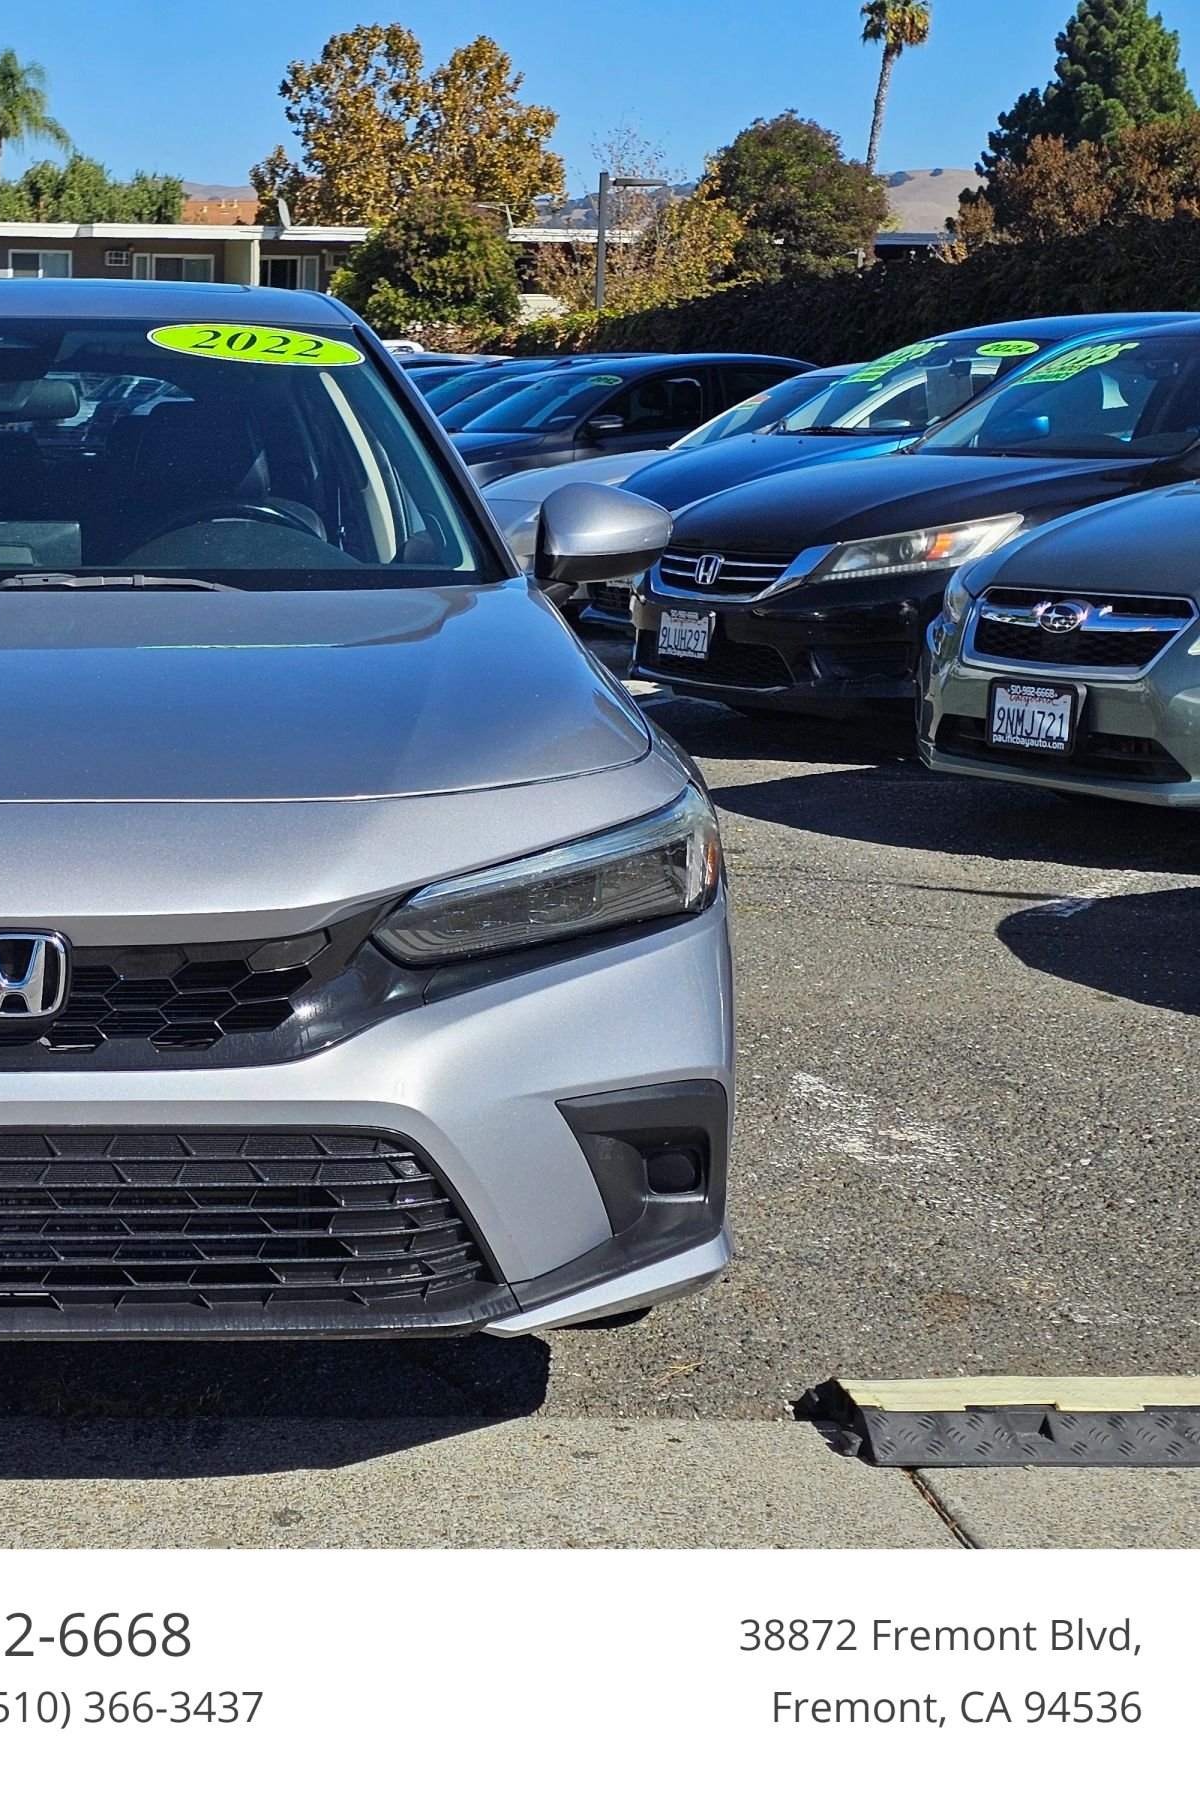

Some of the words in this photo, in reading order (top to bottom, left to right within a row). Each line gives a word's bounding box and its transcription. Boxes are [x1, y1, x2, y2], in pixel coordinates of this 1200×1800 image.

[188, 329, 324, 358] 2022
[659, 626, 707, 652] 9LUH297
[996, 706, 1065, 741] 9NMJ721
[992, 734, 1065, 750] pacificbayauto.com
